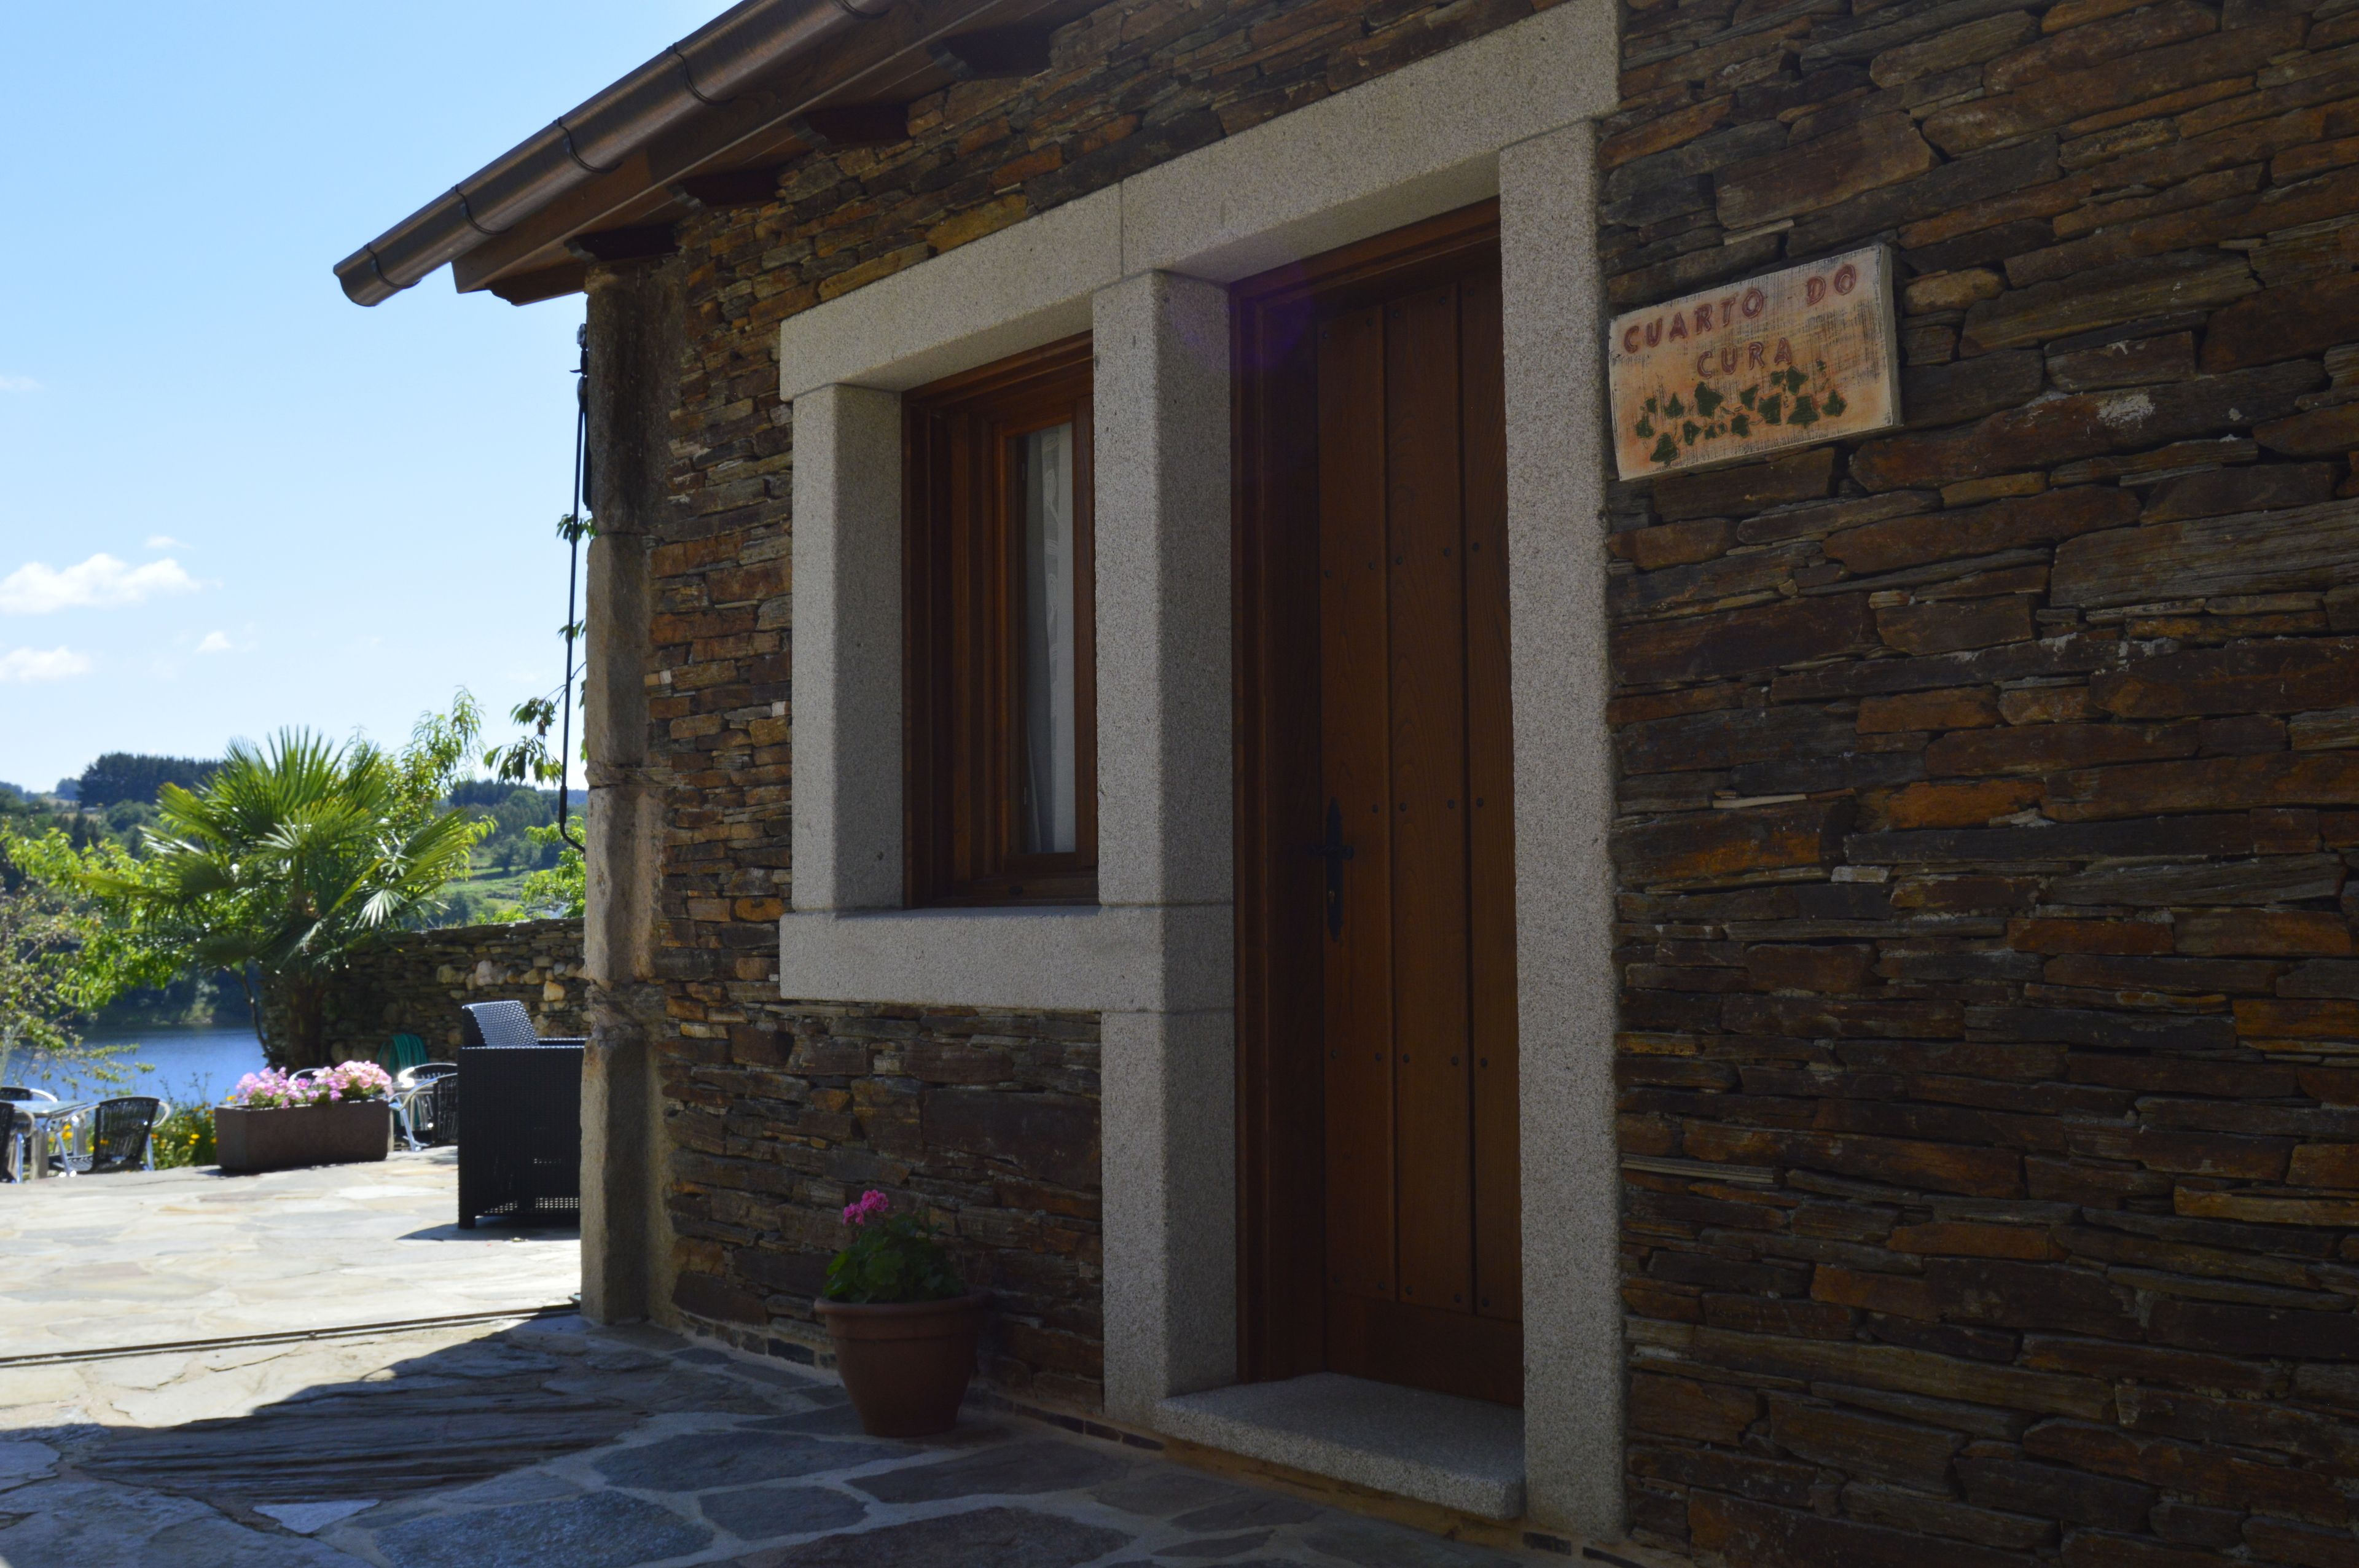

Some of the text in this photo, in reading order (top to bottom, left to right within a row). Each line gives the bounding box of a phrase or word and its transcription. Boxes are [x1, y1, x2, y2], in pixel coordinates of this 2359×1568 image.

[1624, 264, 1856, 354] CUARTO DO
[1697, 338, 1792, 378] CURA
